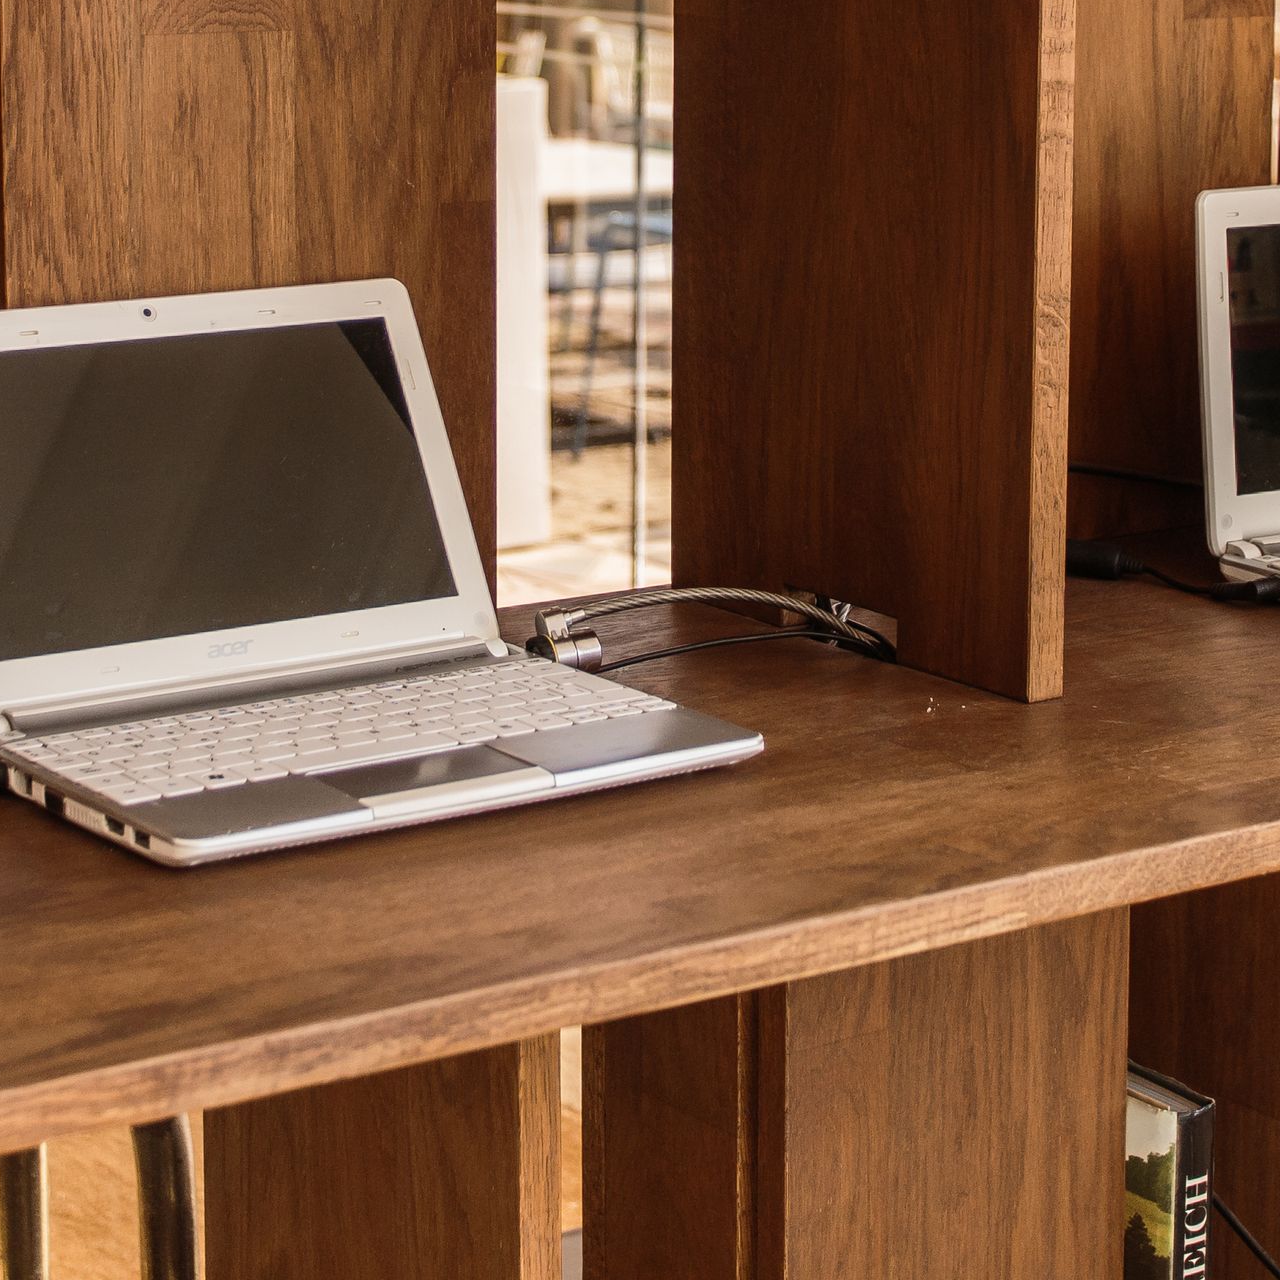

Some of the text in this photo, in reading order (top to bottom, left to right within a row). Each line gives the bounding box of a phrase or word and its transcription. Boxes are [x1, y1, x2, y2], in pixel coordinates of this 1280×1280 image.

[207, 639, 254, 660] acer
[395, 651, 487, 673] ASPIRE ONE
[1183, 1169, 1209, 1280] EICH
